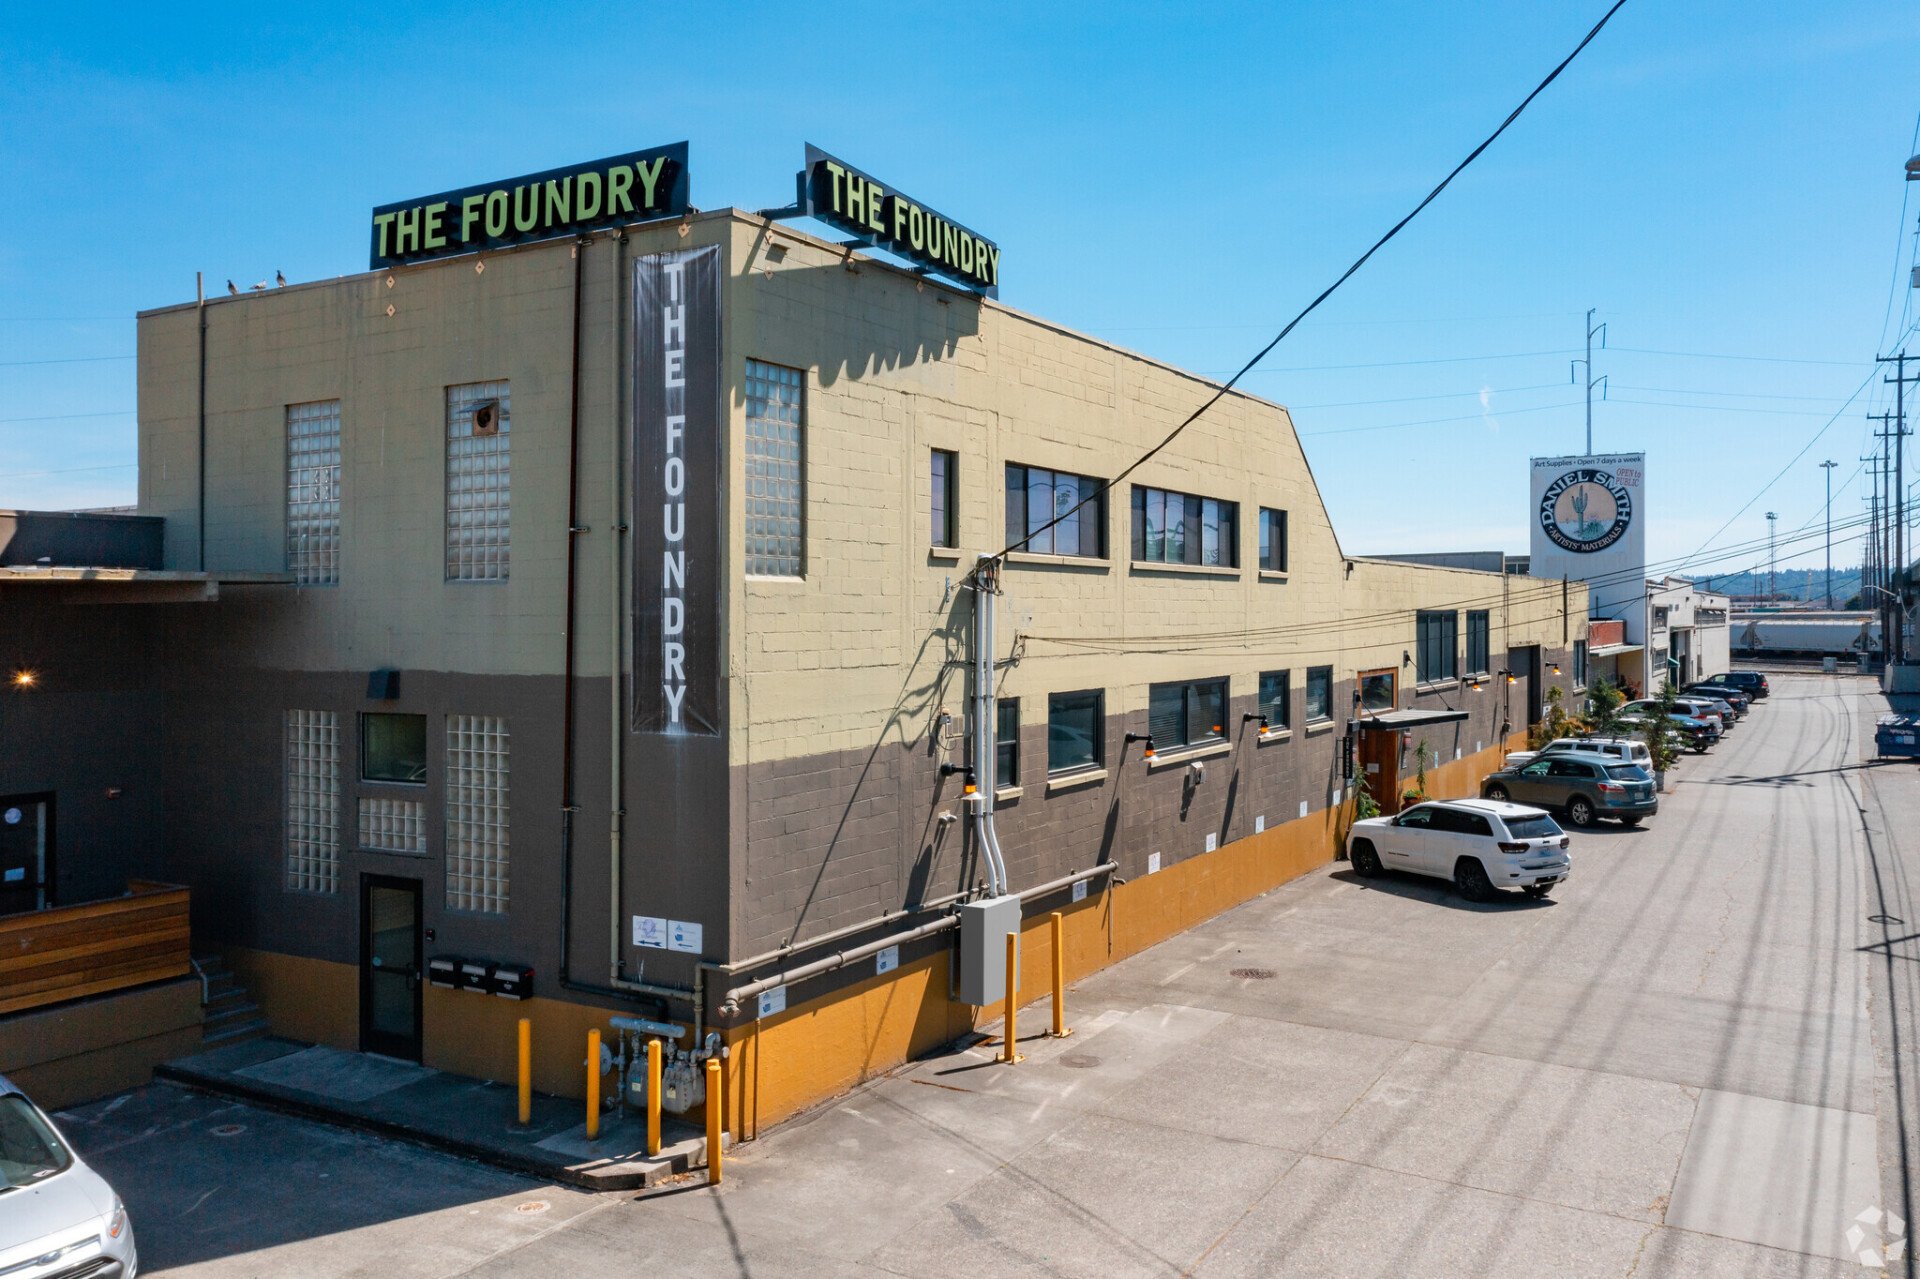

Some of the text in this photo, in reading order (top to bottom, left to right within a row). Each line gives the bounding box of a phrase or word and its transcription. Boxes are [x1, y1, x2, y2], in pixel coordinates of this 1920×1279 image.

[374, 156, 666, 257] THE FOUNDRY
[827, 160, 1001, 286] THE FOUNDRY
[1601, 457, 1616, 465] days
[1616, 467, 1642, 478] OPEN to
[664, 263, 686, 722] THE FOUNDRY
[1542, 471, 1630, 525] DANIEL SMITH
[1615, 476, 1640, 487] PUBLIC
[1581, 526, 1622, 551] MATERIALS
